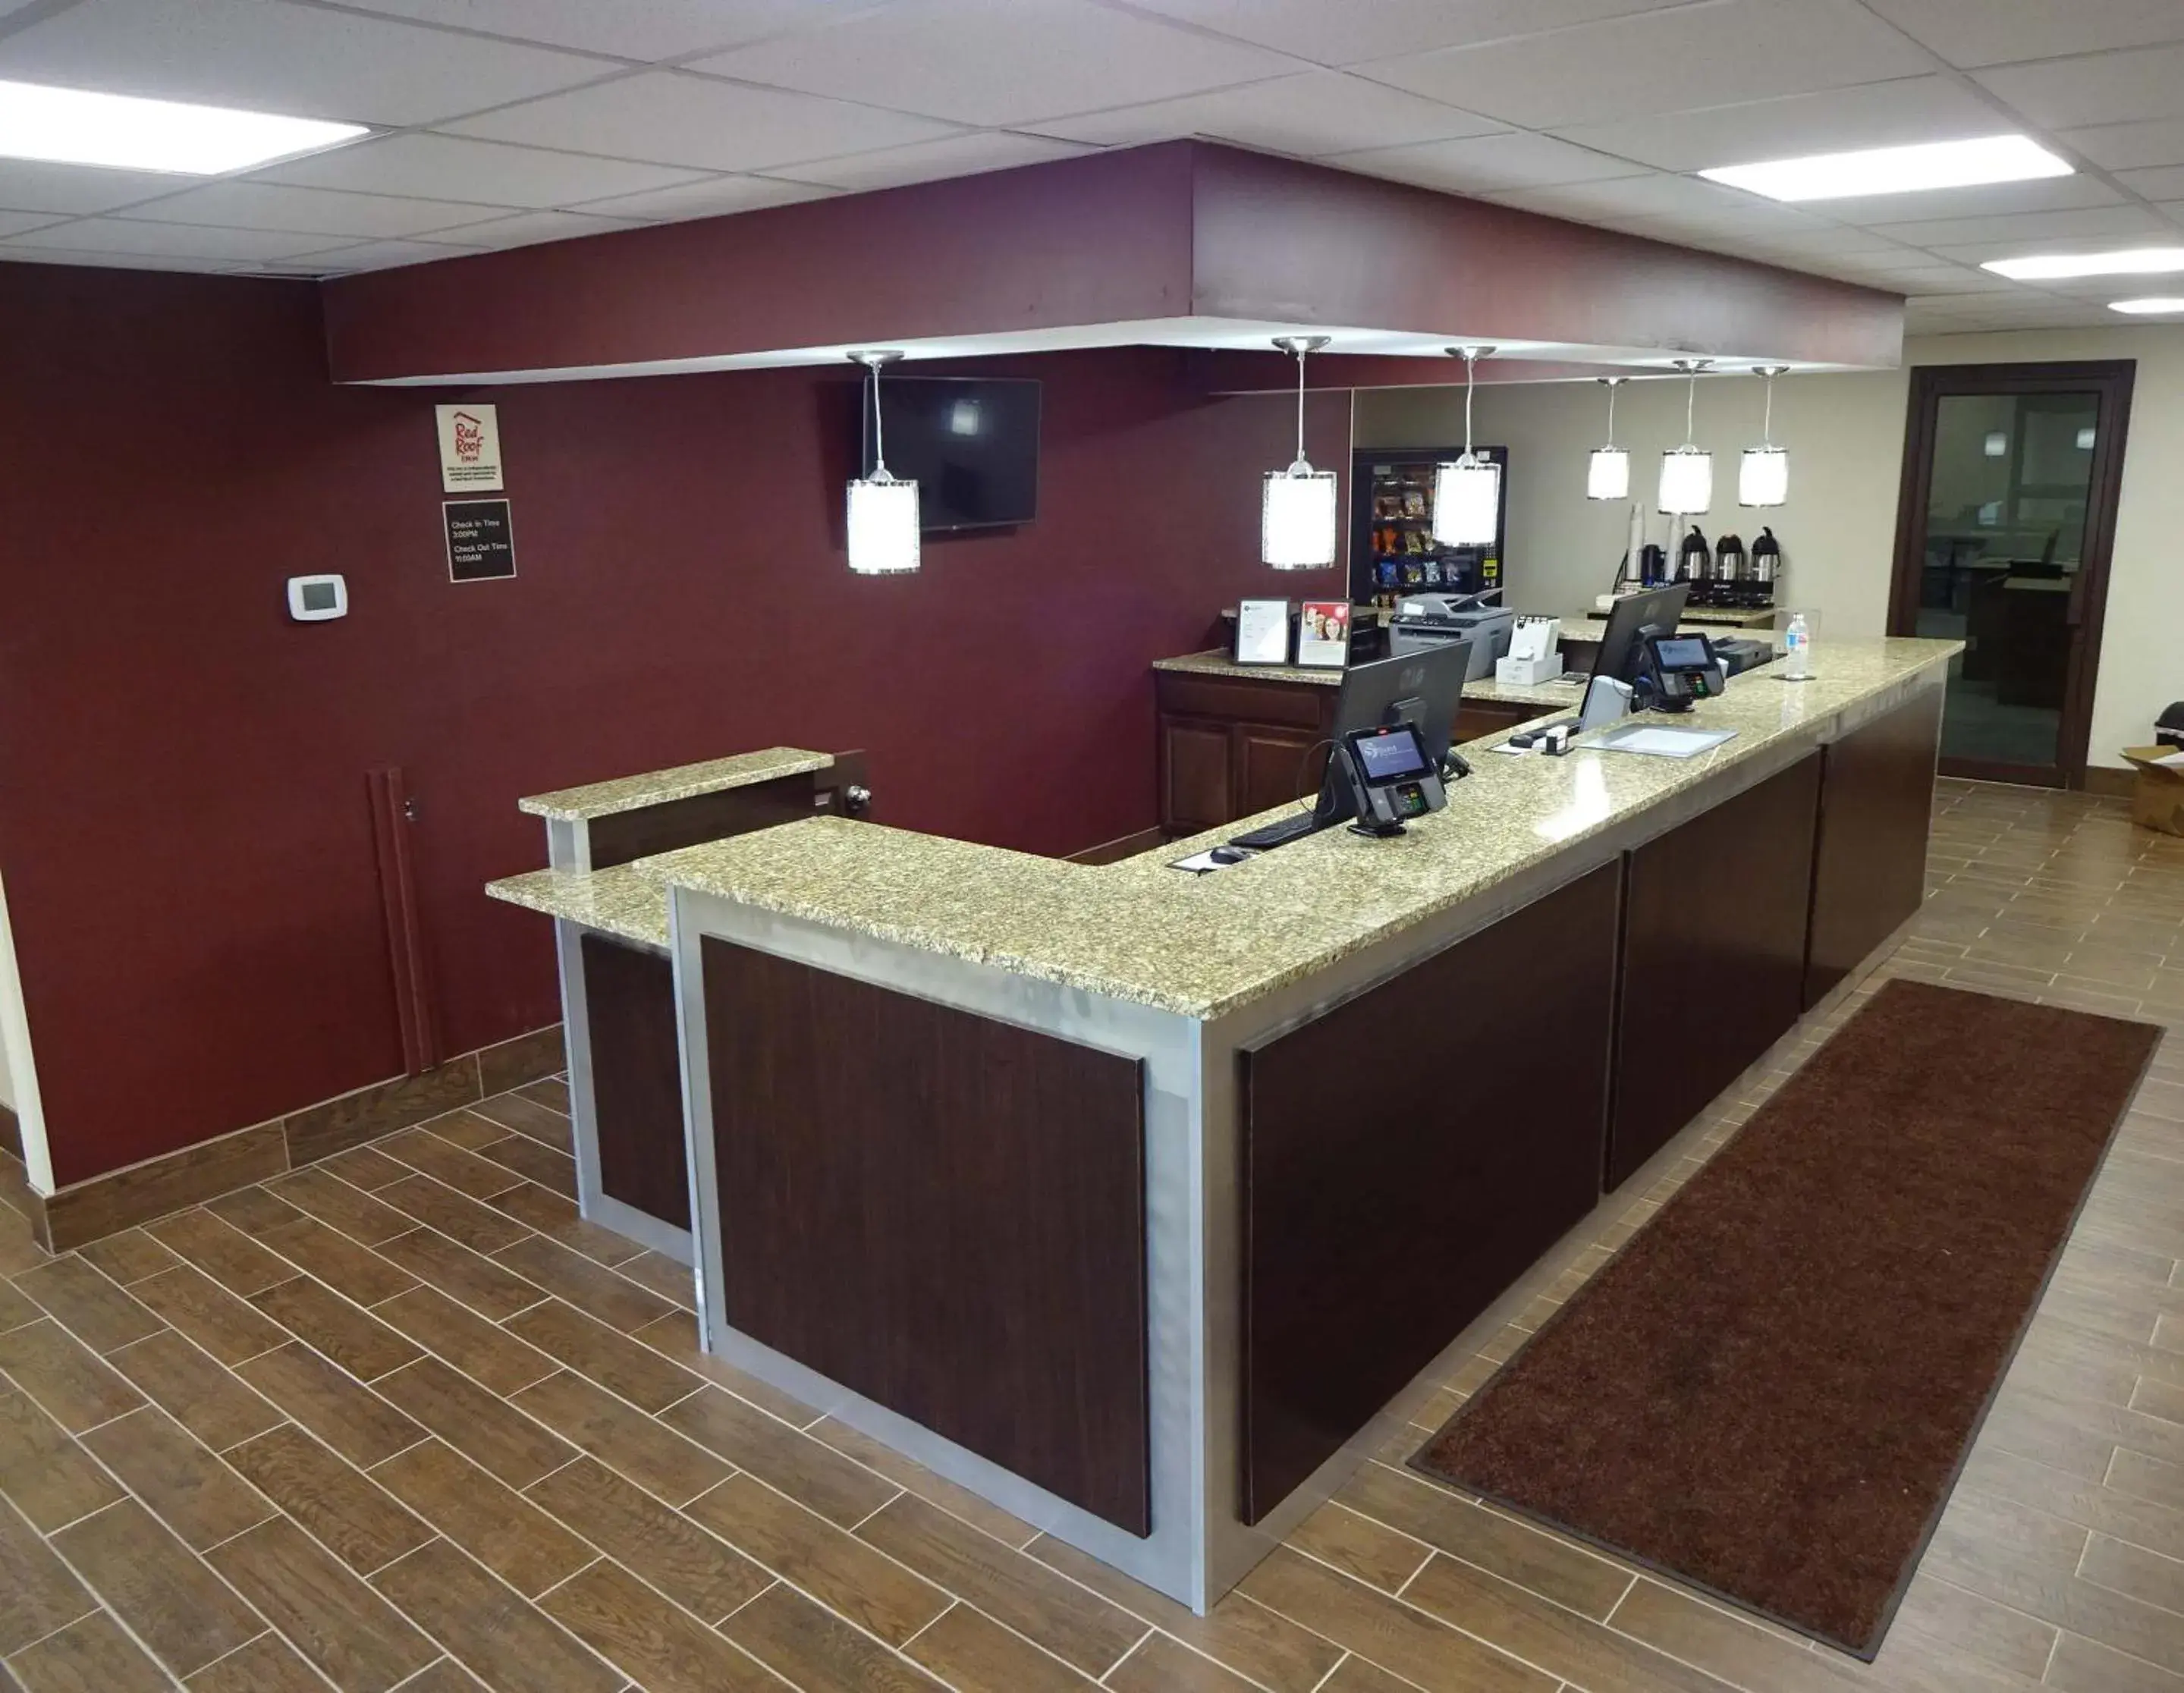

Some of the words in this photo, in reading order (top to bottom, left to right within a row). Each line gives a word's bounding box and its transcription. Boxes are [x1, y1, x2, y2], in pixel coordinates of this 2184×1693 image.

[456, 422, 478, 439] Red
[456, 436, 484, 455] Roof
[451, 521, 473, 529] Check
[483, 519, 500, 527] Time
[454, 545, 476, 554] Check
